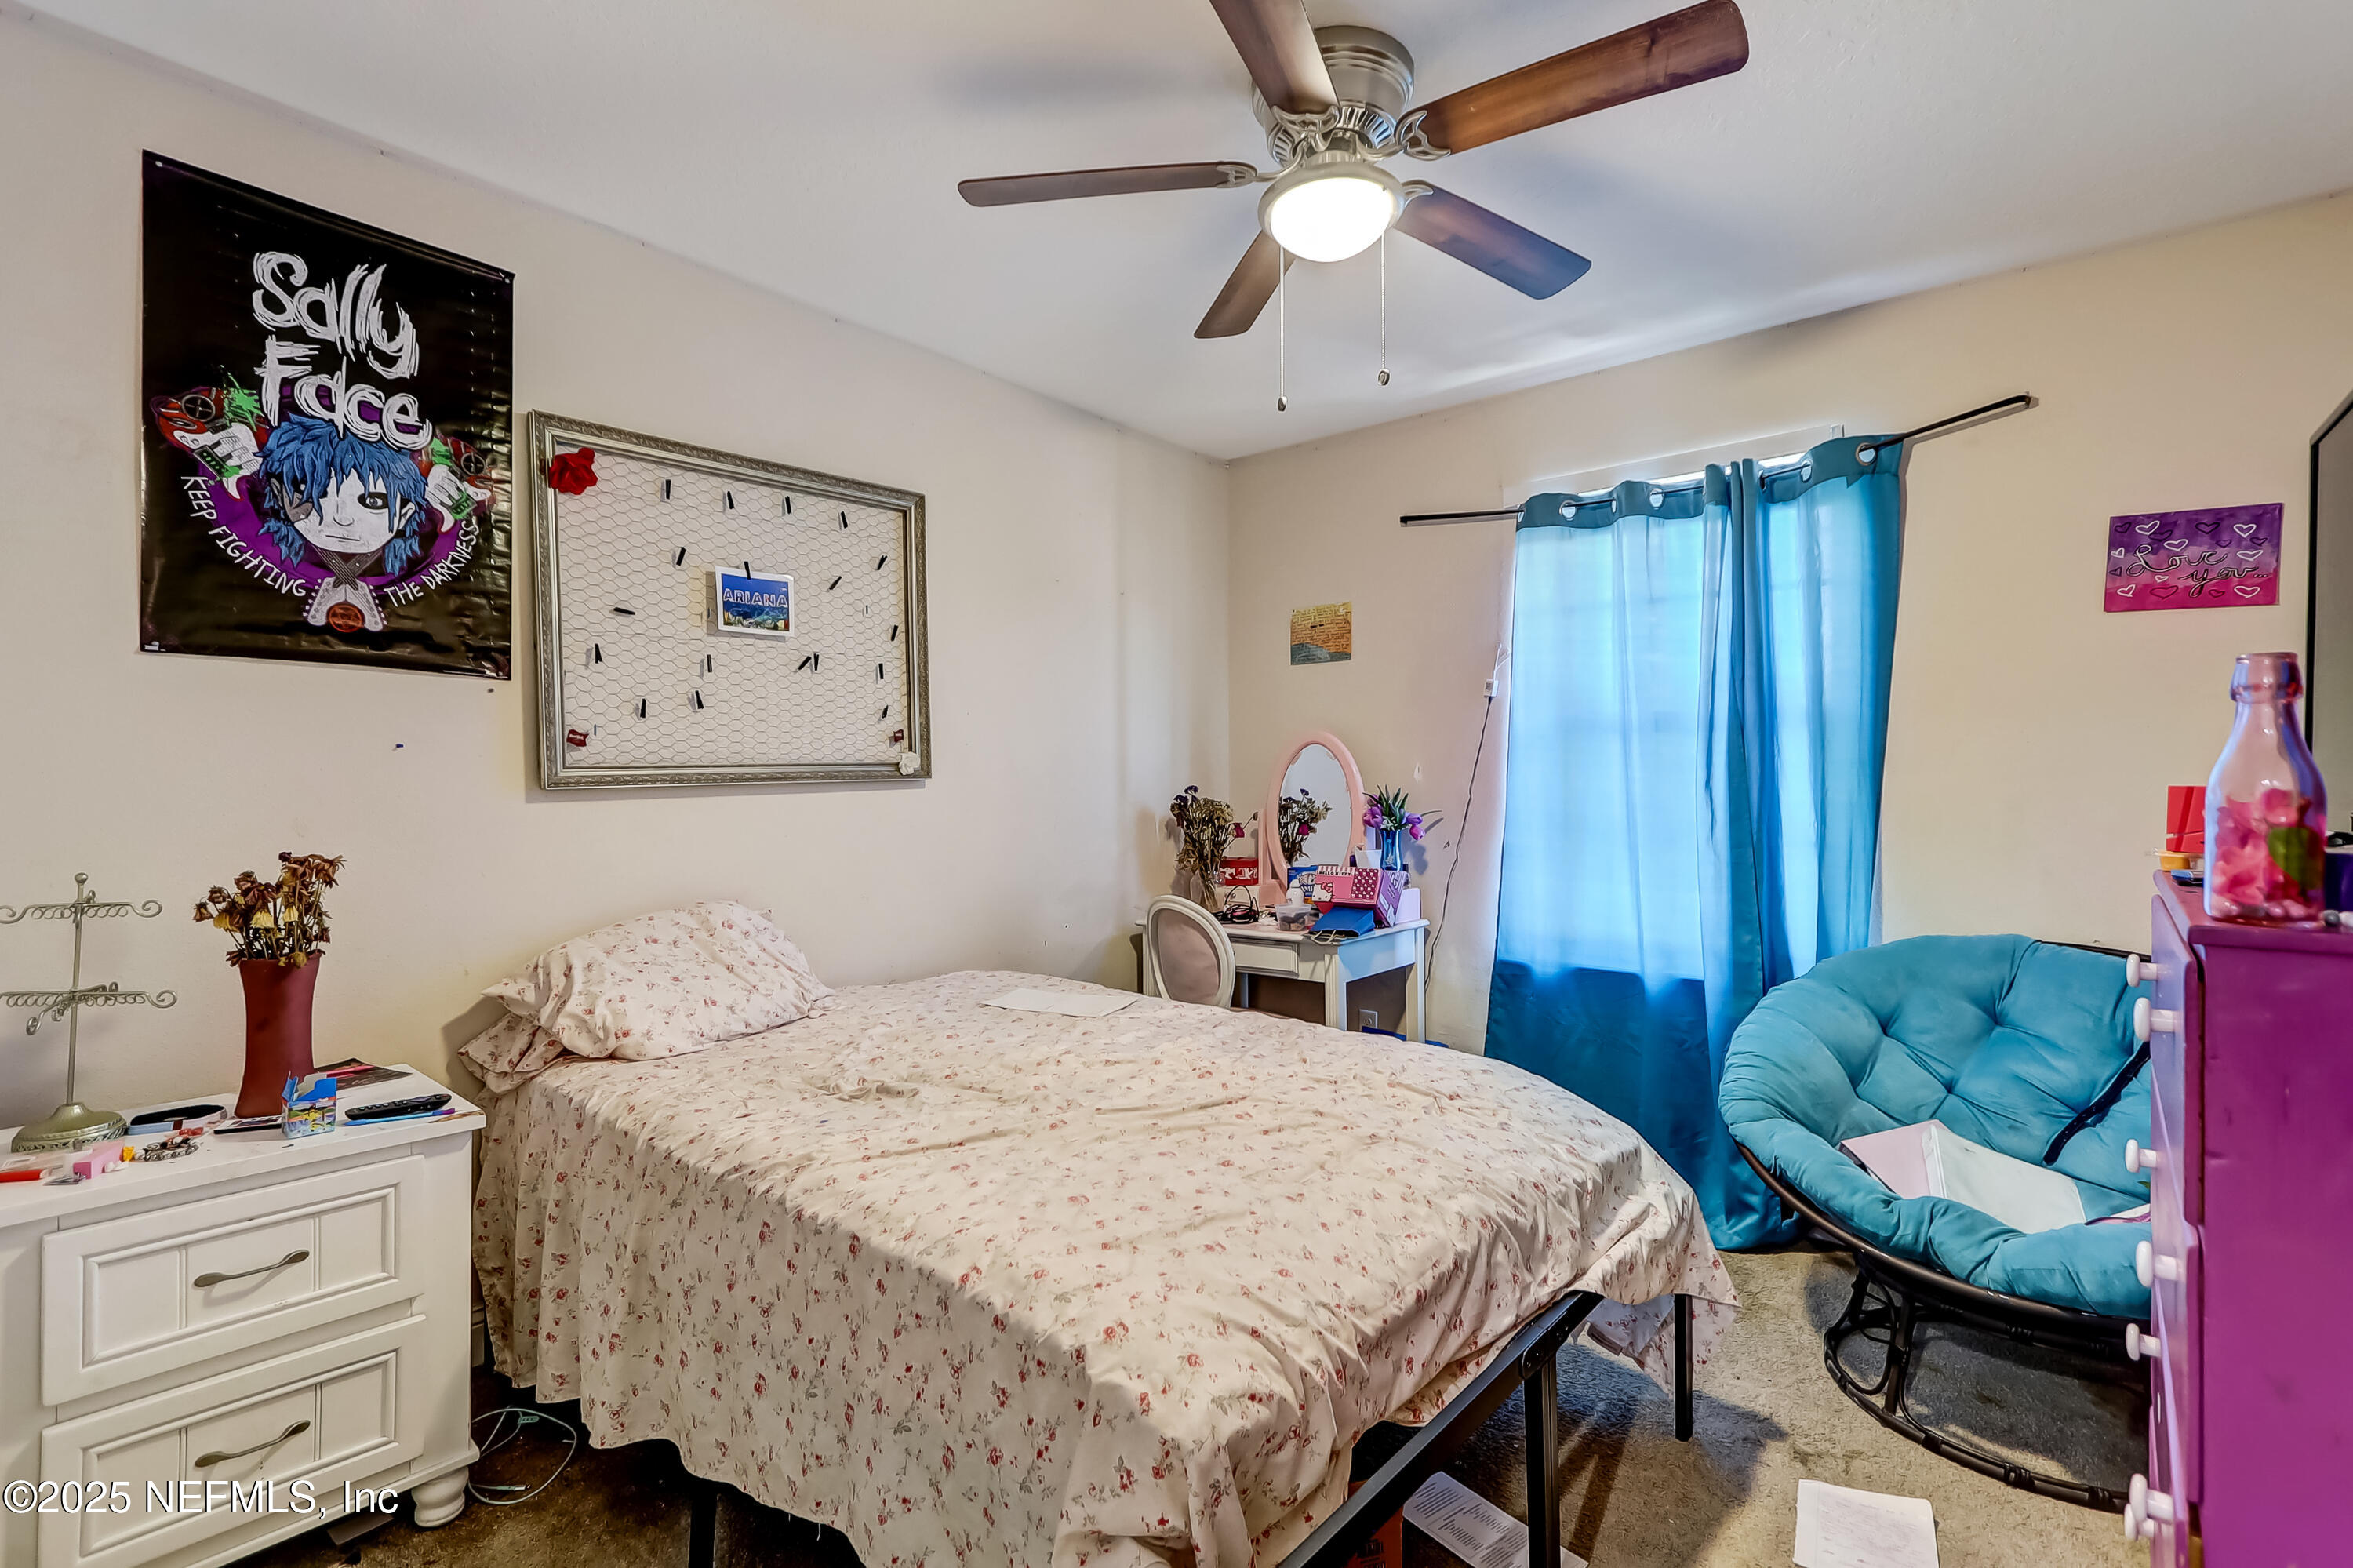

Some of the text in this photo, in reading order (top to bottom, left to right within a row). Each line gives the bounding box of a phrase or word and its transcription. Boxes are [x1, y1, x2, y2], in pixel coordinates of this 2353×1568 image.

[252, 251, 420, 379] Sally
[253, 334, 433, 451] Face
[180, 476, 479, 607] KEEP FIGHTING THE DARKNESS
[723, 588, 788, 608] ARIANA
[2126, 544, 2228, 577] Love
